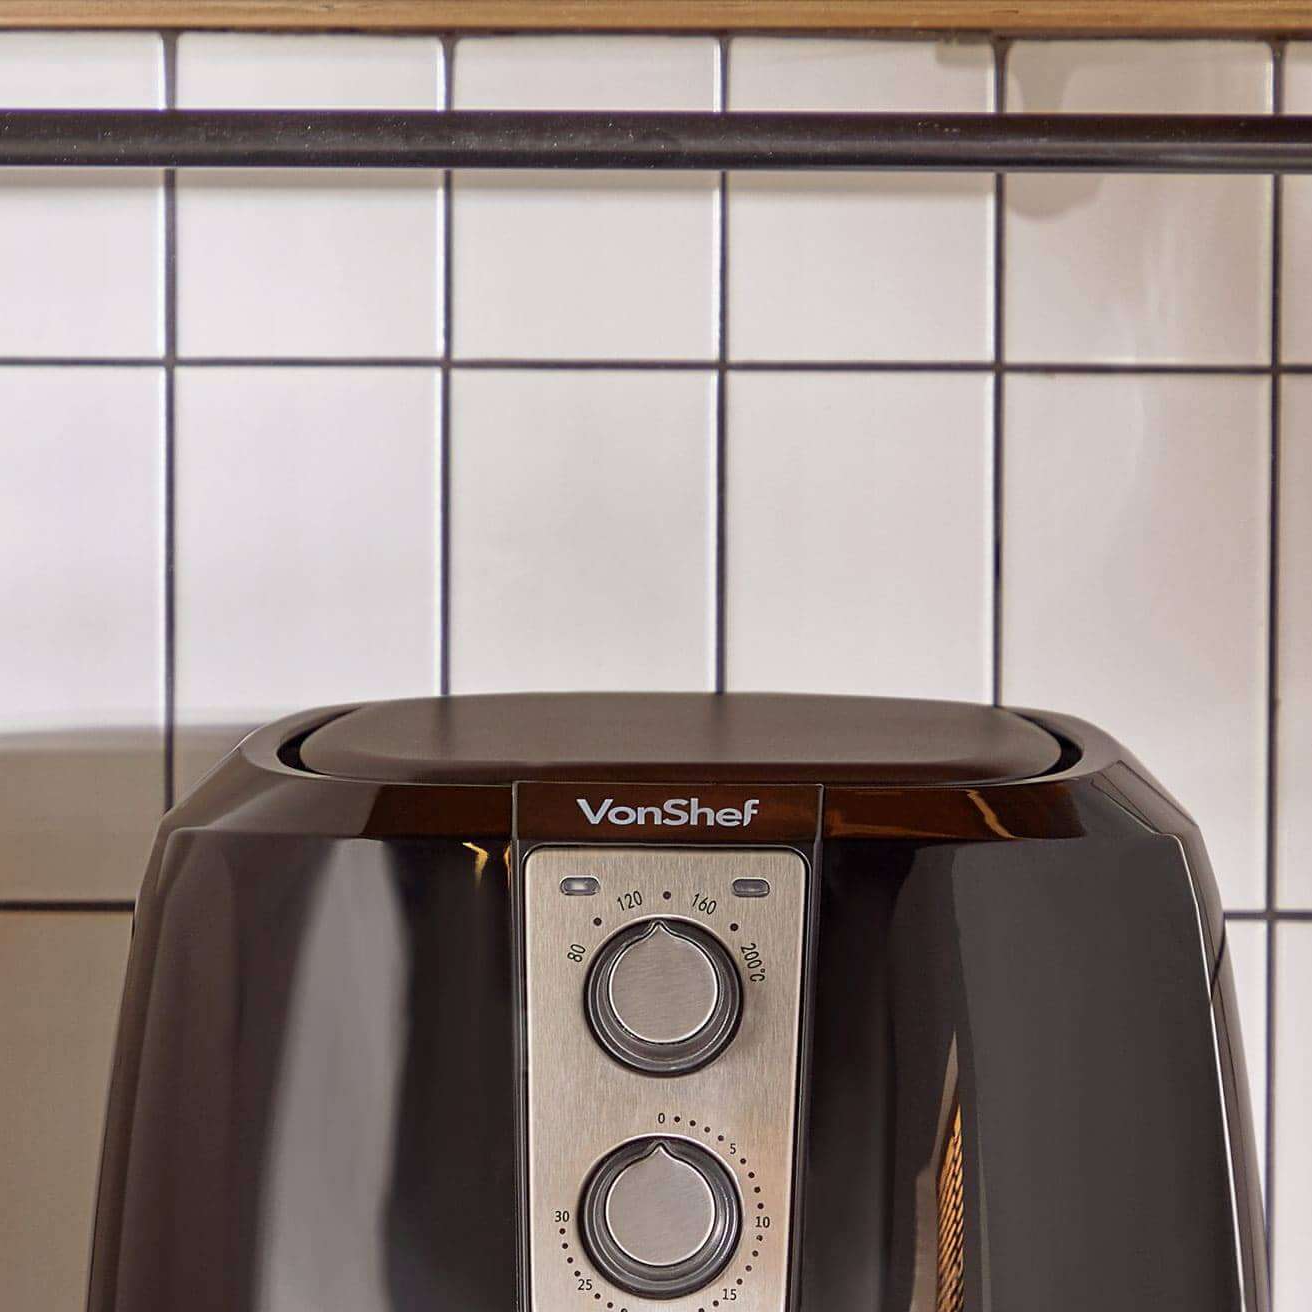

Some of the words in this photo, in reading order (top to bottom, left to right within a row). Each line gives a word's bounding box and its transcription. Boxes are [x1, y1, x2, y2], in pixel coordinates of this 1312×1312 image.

[576, 798, 760, 826] VonShef
[617, 890, 643, 912] 120
[691, 893, 717, 916] 160
[567, 943, 586, 963] 80
[657, 1113, 666, 1124] 0
[729, 1143, 737, 1155] 5
[554, 1210, 570, 1224] 30
[755, 1216, 771, 1229] 10
[577, 1279, 593, 1292] 25
[722, 1289, 737, 1301] 15
